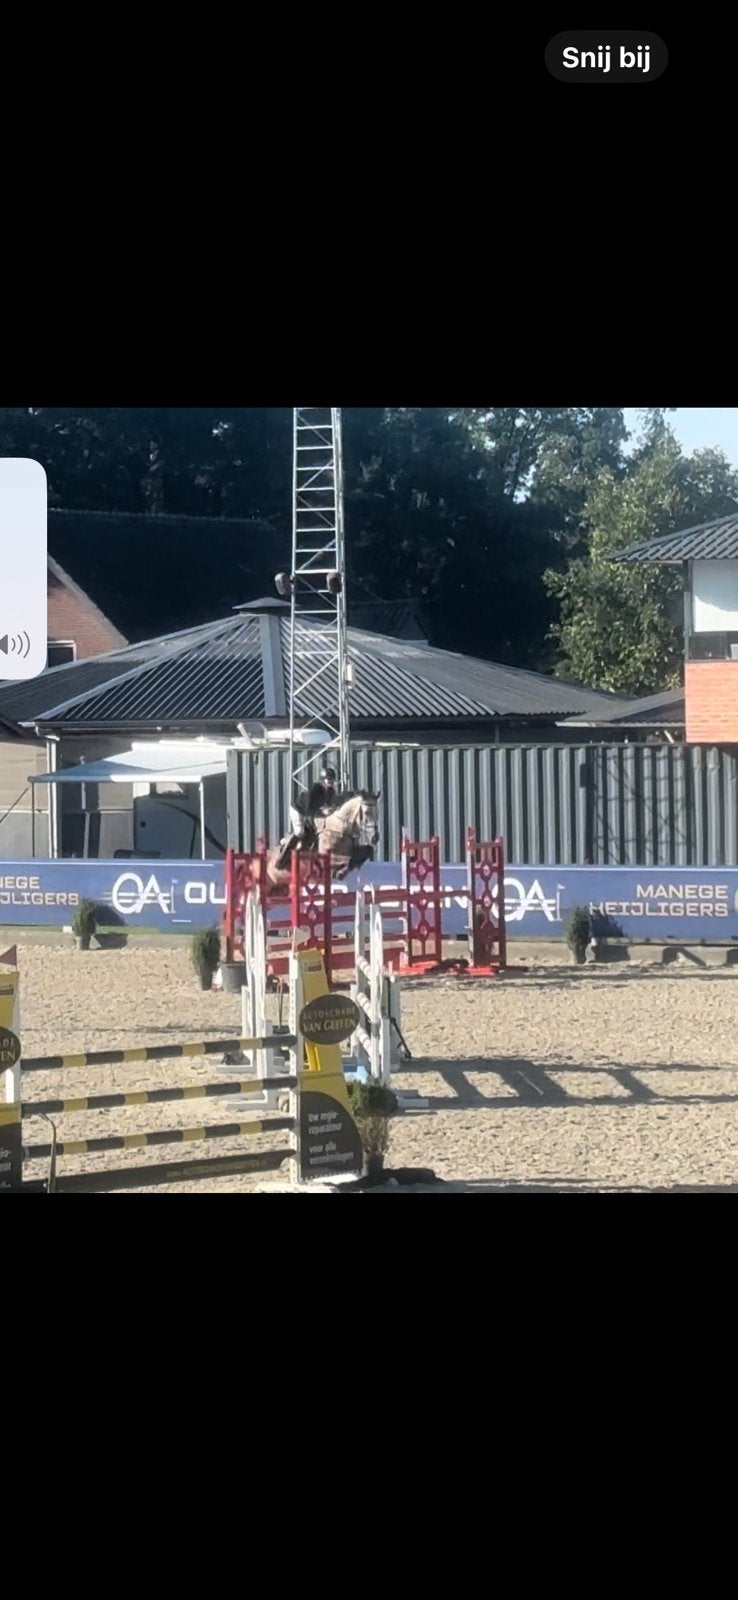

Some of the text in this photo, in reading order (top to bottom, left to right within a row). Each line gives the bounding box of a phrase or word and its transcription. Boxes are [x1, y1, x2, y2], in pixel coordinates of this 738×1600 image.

[0, 876, 40, 889] EGE
[636, 884, 728, 899] MANEGE
[589, 901, 728, 917] HEIJLIGERS
[303, 1022, 322, 1032] VAN
